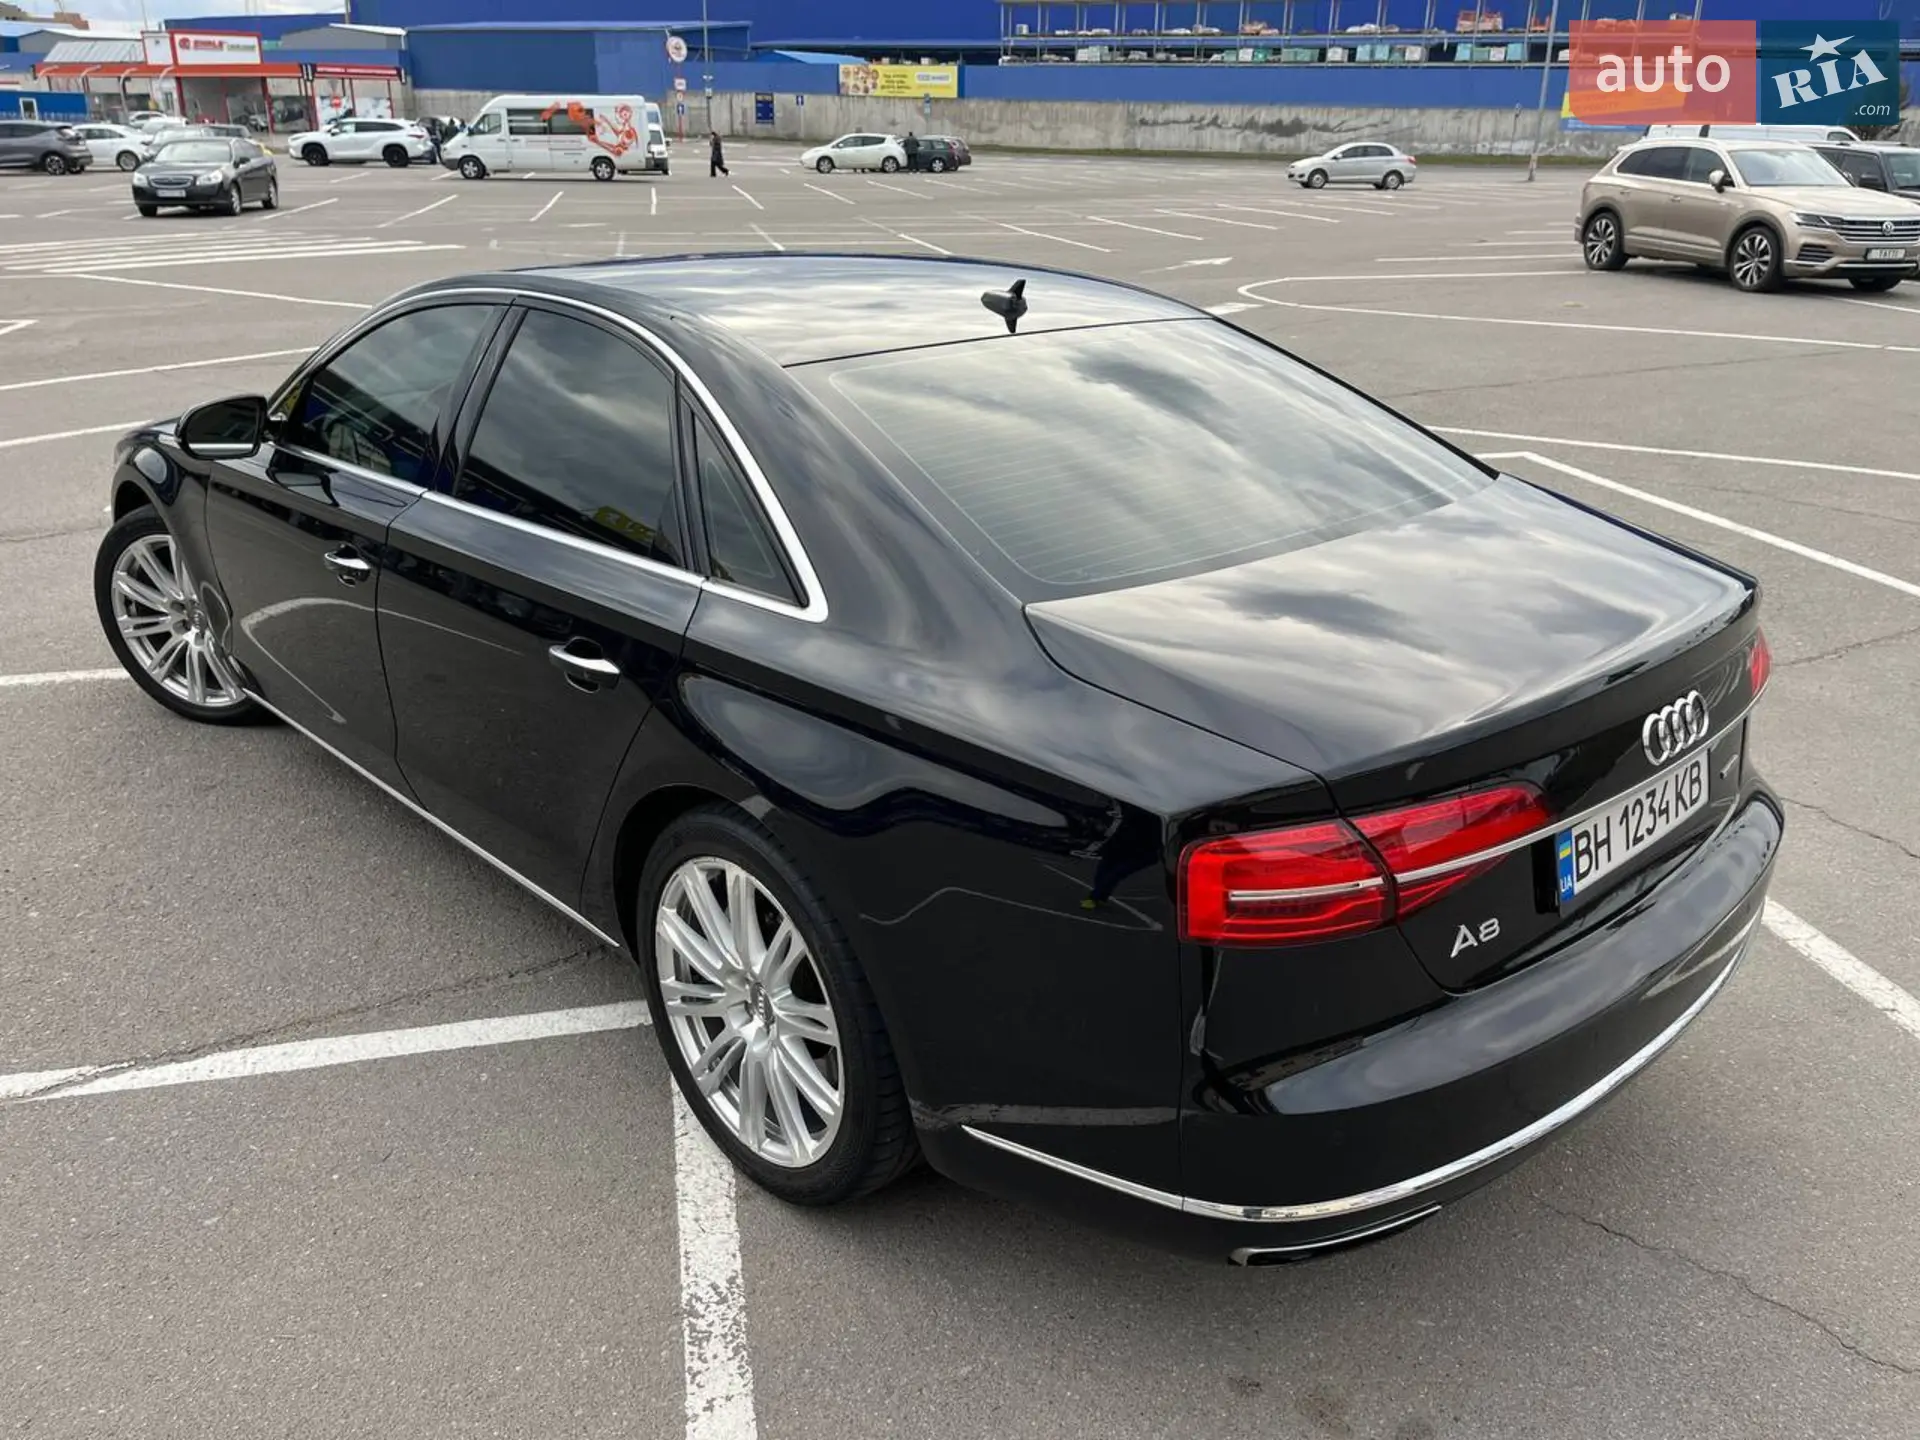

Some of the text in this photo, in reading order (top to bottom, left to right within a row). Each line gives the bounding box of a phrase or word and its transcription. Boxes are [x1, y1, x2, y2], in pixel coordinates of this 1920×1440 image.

[1574, 760, 1702, 883] BH 1234 KB
[1560, 874, 1573, 892] UA
[1450, 918, 1500, 958] A8
